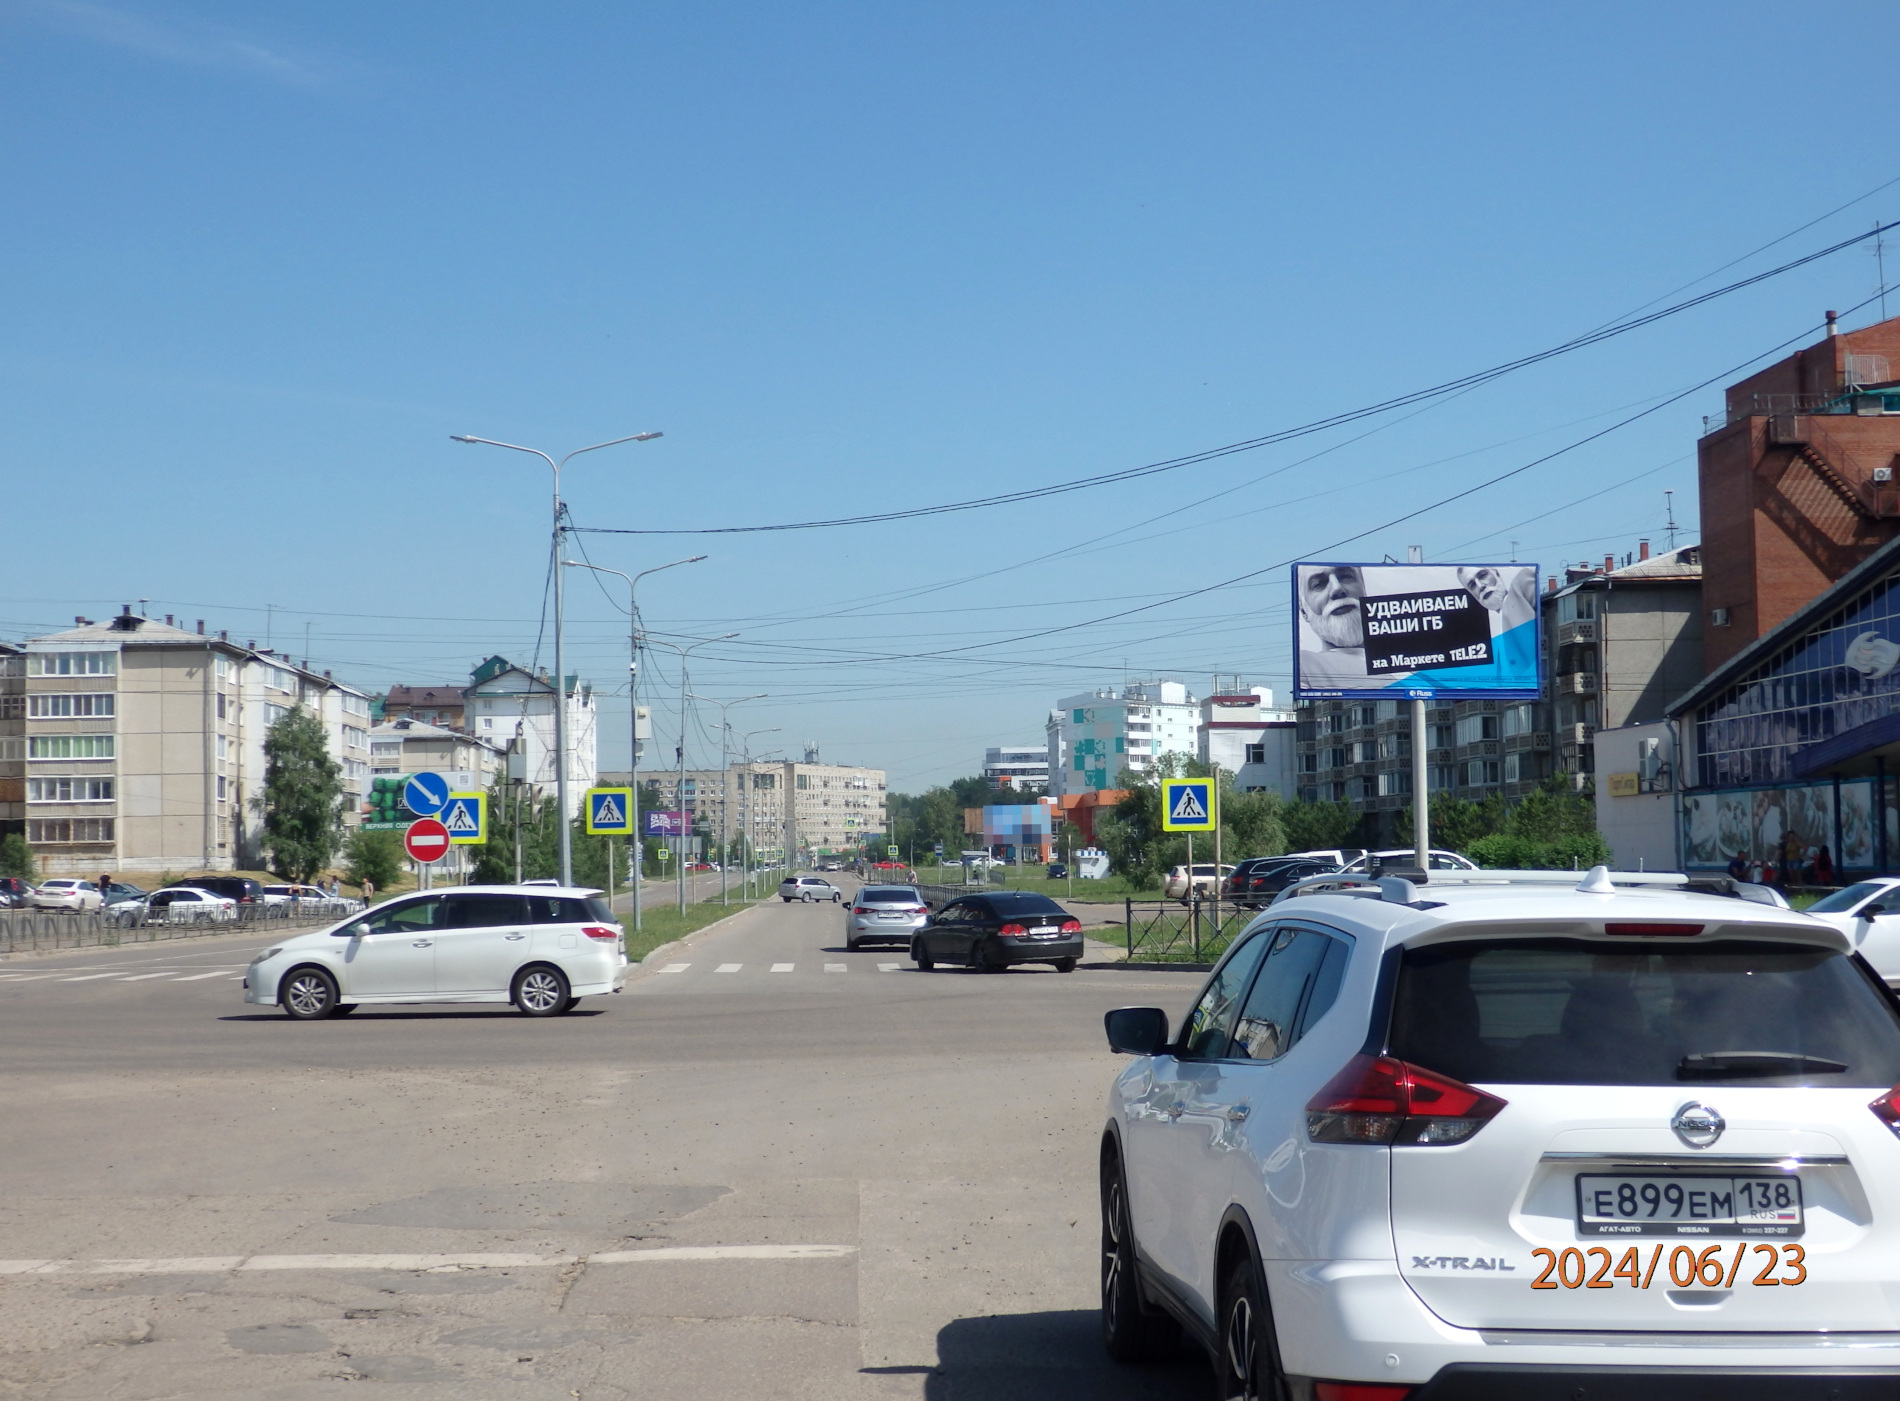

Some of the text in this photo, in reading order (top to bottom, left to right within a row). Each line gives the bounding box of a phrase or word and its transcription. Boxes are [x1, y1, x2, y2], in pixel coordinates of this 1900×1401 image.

[1365, 595, 1468, 618] УДВАИВАЕМ
[1368, 615, 1443, 636] ВАШИ ГБ
[1372, 643, 1487, 669] на Маркете TELE2
[1594, 1183, 1733, 1218] Е899ЕМ
[1739, 1182, 1791, 1209] 138
[1750, 1209, 1776, 1220] RUS
[1412, 1256, 1515, 1271] X-TRAIL
